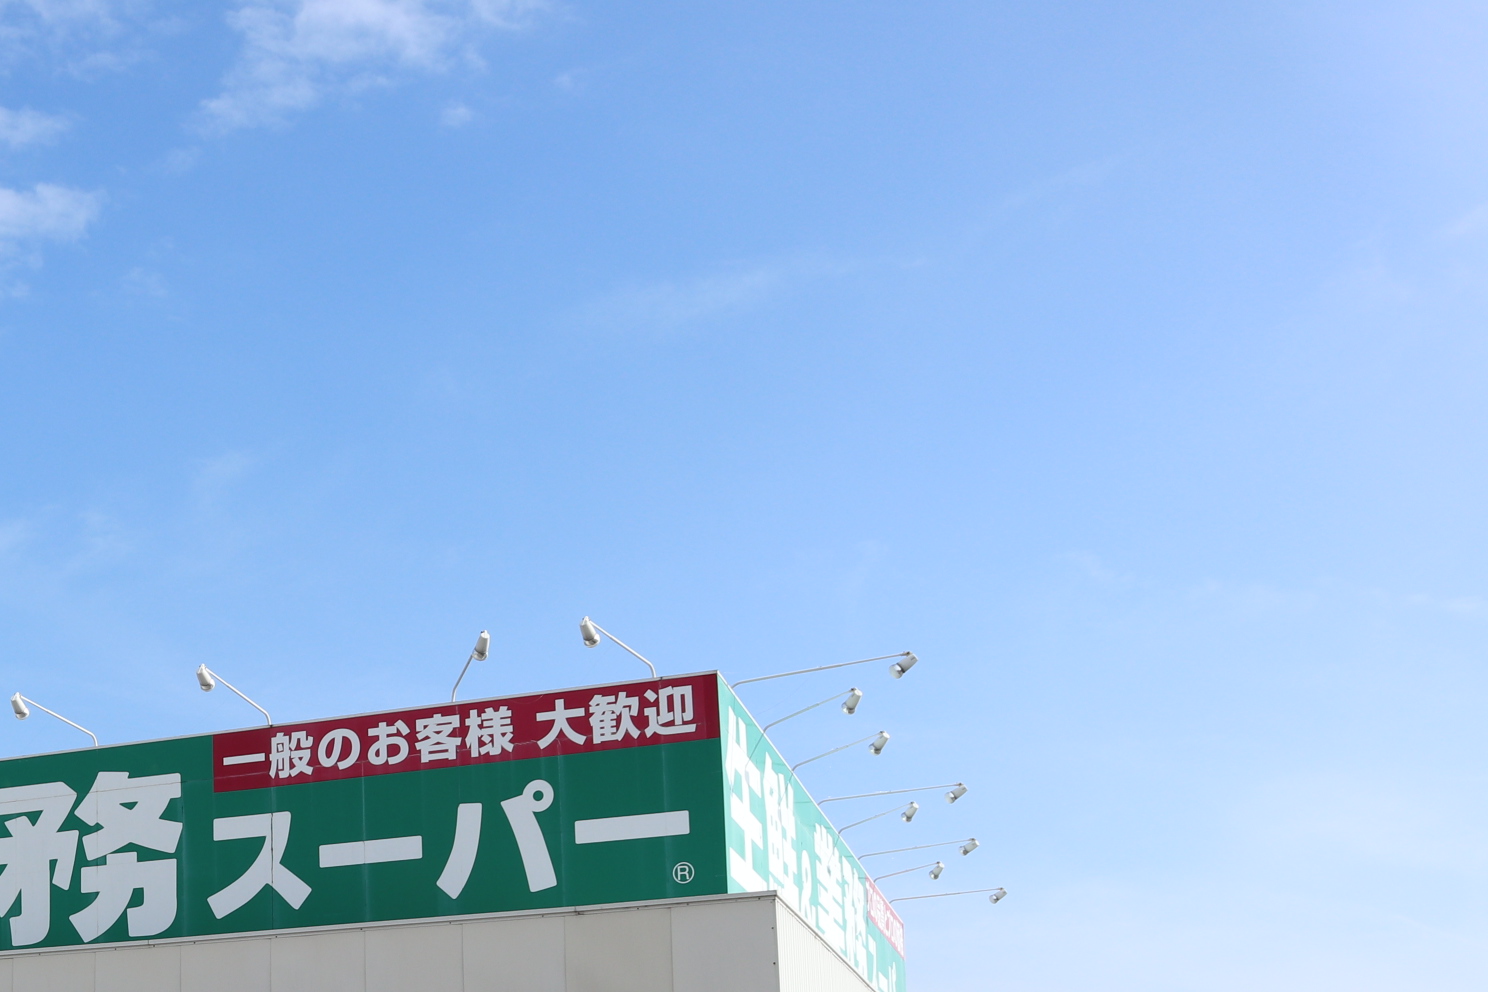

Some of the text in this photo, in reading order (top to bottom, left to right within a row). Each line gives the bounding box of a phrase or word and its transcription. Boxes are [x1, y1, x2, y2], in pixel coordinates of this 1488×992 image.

[223, 685, 698, 780] 一般のお客様 大歓迎
